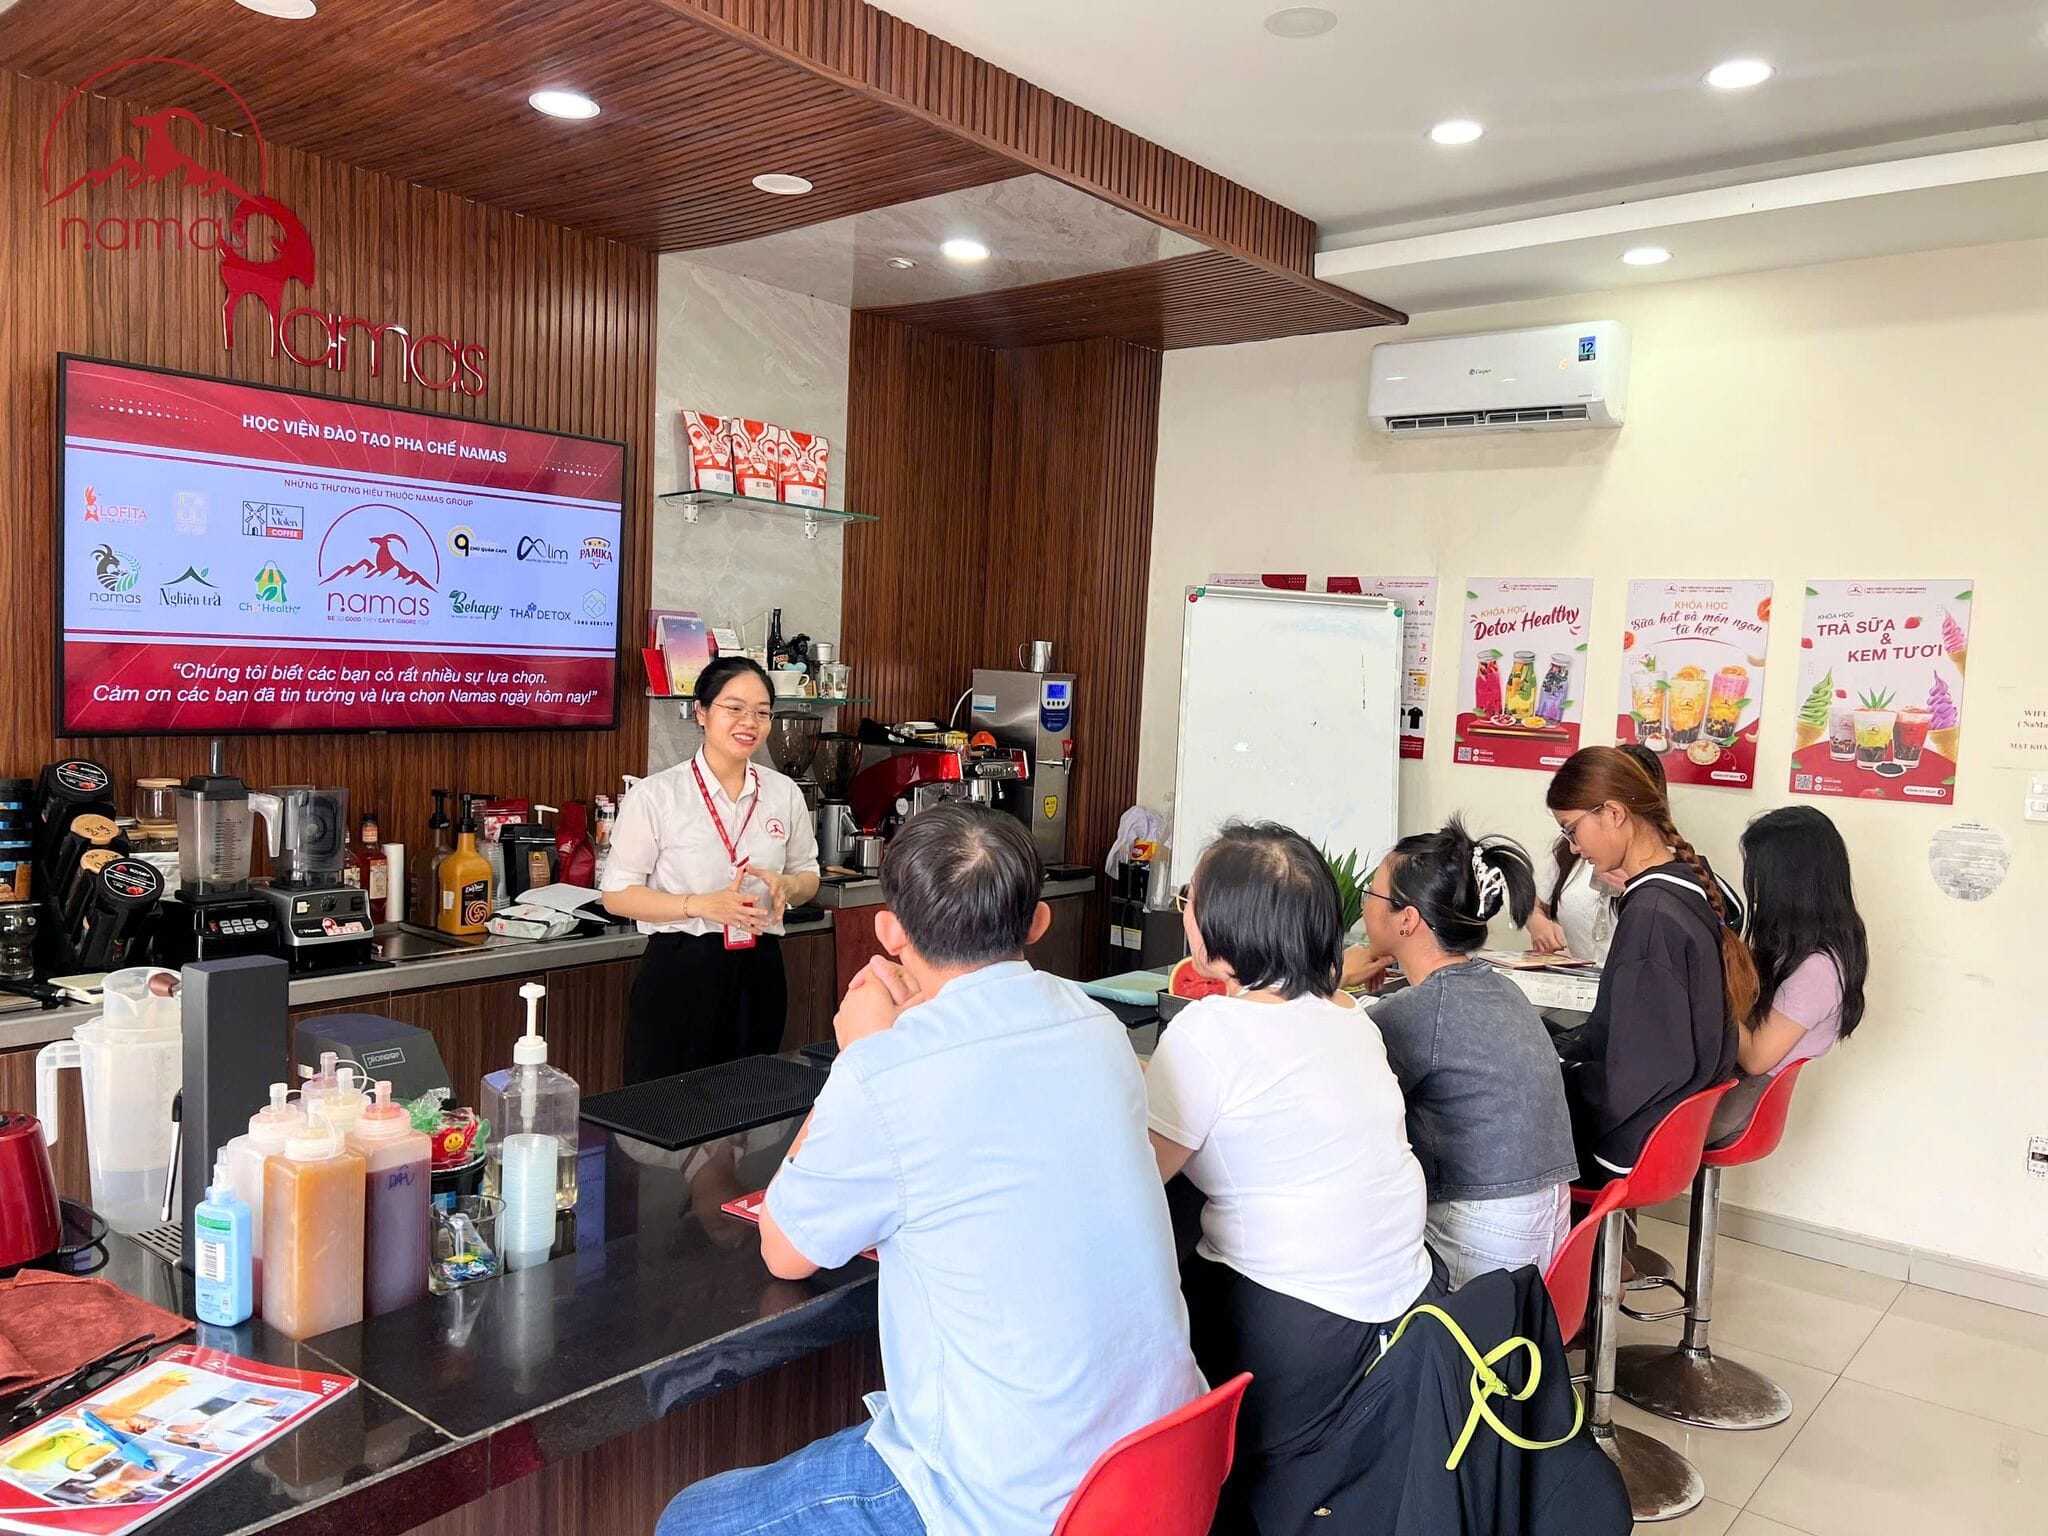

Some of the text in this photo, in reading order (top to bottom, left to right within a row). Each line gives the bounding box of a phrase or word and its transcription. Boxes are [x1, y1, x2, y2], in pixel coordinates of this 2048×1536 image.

[219, 250, 488, 396] namas
[1581, 342, 1594, 354] 12
[242, 414, 508, 464] HỌC VIỆN ĐÀO TẠO PHA CHẾ NAMAS
[321, 482, 361, 496] THƯƠNG
[385, 489, 415, 501] THUỘC
[415, 493, 445, 505] NAMAS
[445, 496, 474, 507] GROUP
[100, 505, 148, 520] LOFITA
[271, 528, 299, 538] COFFEE
[580, 547, 613, 562] PAMIKA
[89, 592, 142, 604] namas
[328, 592, 430, 616] namas
[1480, 604, 1527, 619] KHÓA HỌC
[1674, 600, 1728, 612] KHÓA HỌC
[537, 609, 571, 621] DETOX
[1474, 604, 1580, 641] Detox Healthy
[1817, 611, 1855, 620] KHÓA HỌC
[1660, 611, 1680, 625] hạt
[1684, 611, 1698, 622] và
[1702, 612, 1730, 625] món
[1732, 618, 1763, 635] ngon
[1694, 623, 1720, 638] hạt
[1816, 616, 1896, 636] TRÀ SỮA
[1880, 633, 1892, 645] &
[1847, 644, 1943, 663] KEM TƯƠI
[173, 662, 548, 687] “Chúng tôi biết các bạn có rất nhiều sự lựa chọn.
[93, 684, 599, 706] Cảm ơn các bạn đã tin tưởng và lựa chọn Namas ngày hôm nay!”
[2024, 709, 2047, 718] WIFI
[367, 1050, 401, 1066] pioneer
